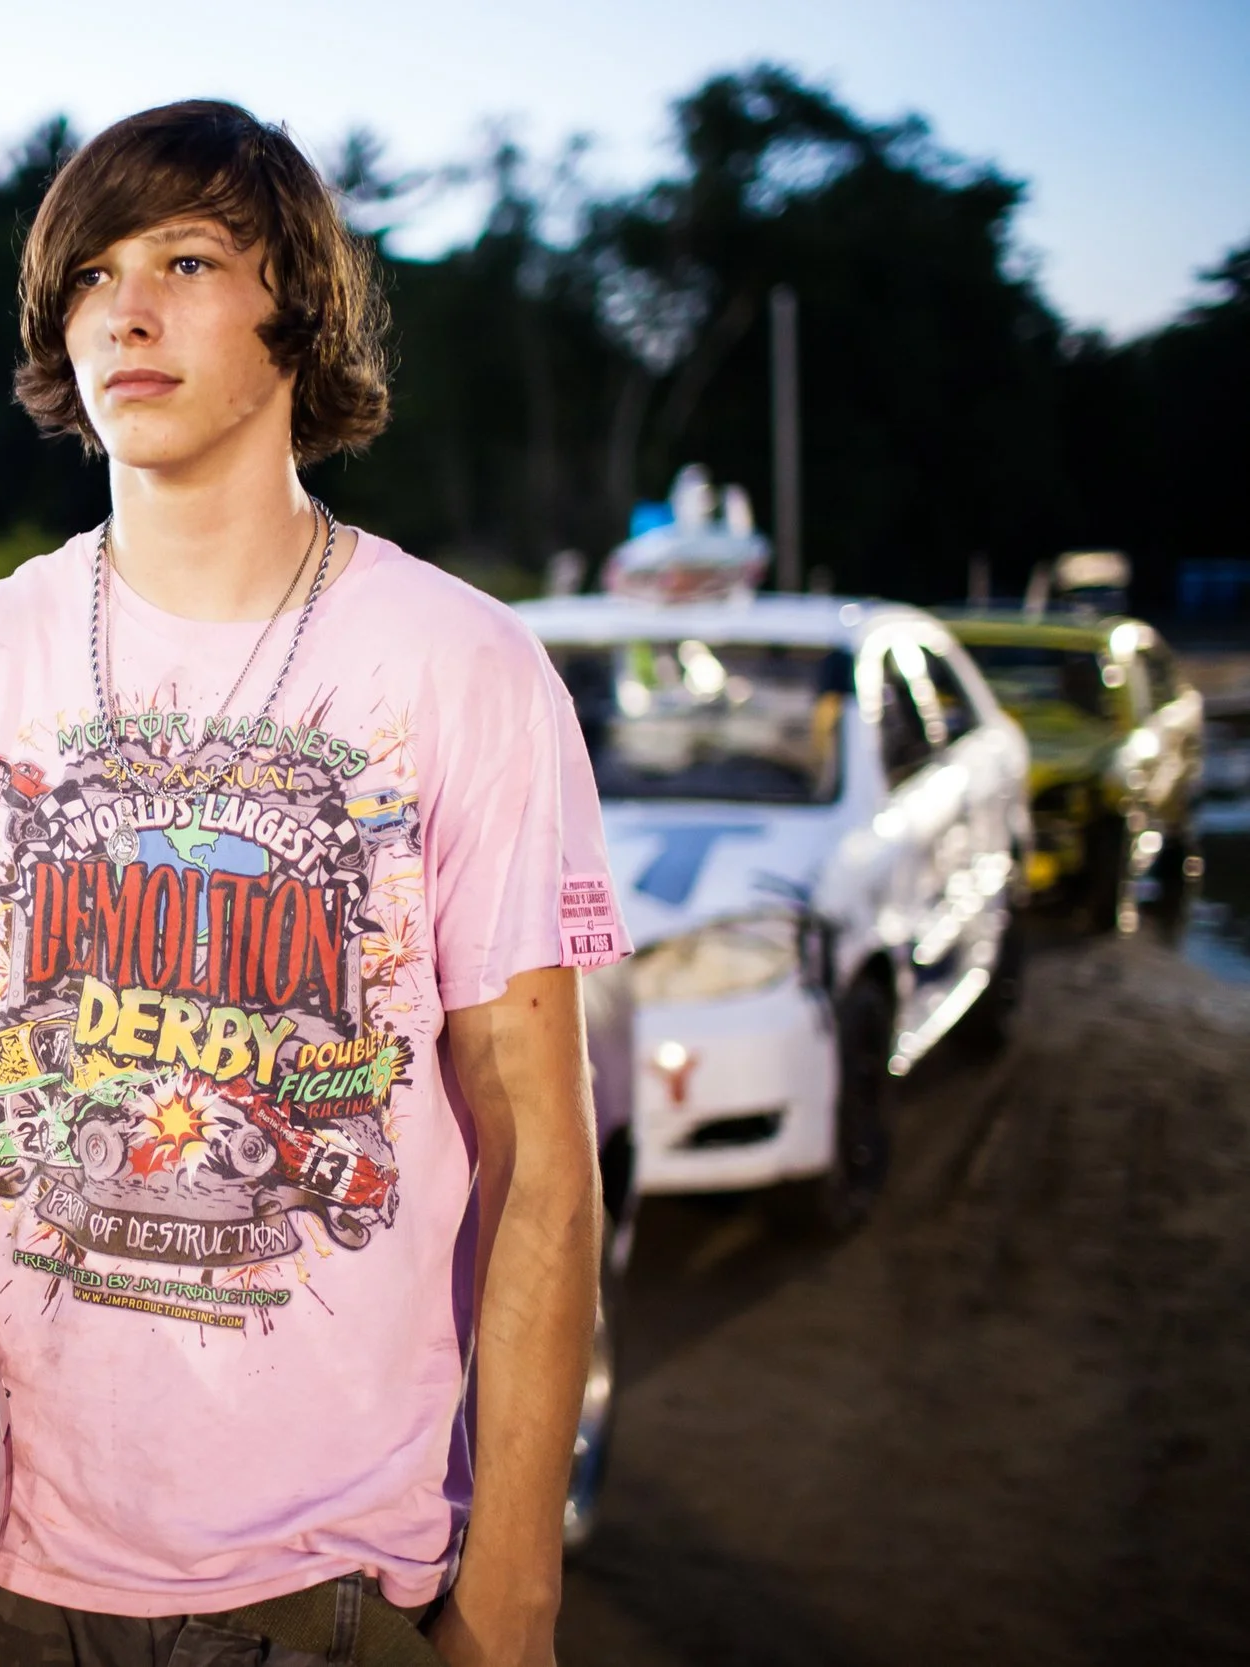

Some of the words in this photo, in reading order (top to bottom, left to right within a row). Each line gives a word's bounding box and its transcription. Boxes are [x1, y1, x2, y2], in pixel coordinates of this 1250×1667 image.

[58, 708, 191, 754] MOTOR
[202, 715, 369, 779] MADNESS
[163, 763, 303, 791] ANNUAL
[199, 793, 328, 873] LARGEST
[562, 907, 592, 919] DEMOLITION
[593, 906, 608, 917] DERBY
[587, 893, 606, 904] LARGEST
[27, 860, 347, 1016] DEMOLITION
[575, 936, 588, 954] PIT
[589, 934, 609, 952] PASS
[74, 974, 298, 1086] DERBY
[372, 1045, 400, 1098] 8
[308, 1097, 373, 1119] RACING
[17, 1117, 49, 1153] 20
[304, 1145, 349, 1197] 13
[48, 1189, 89, 1230] PATH
[90, 1210, 122, 1244] OF
[126, 1216, 288, 1260] DESTRUCTION
[13, 1251, 102, 1286] PRESENTED
[108, 1275, 133, 1290] BY
[133, 1278, 160, 1294] JM
[164, 1282, 291, 1306] PRODUCTIONS
[74, 1288, 244, 1328] WWW.JMPRODUCTIONSINC.COM
